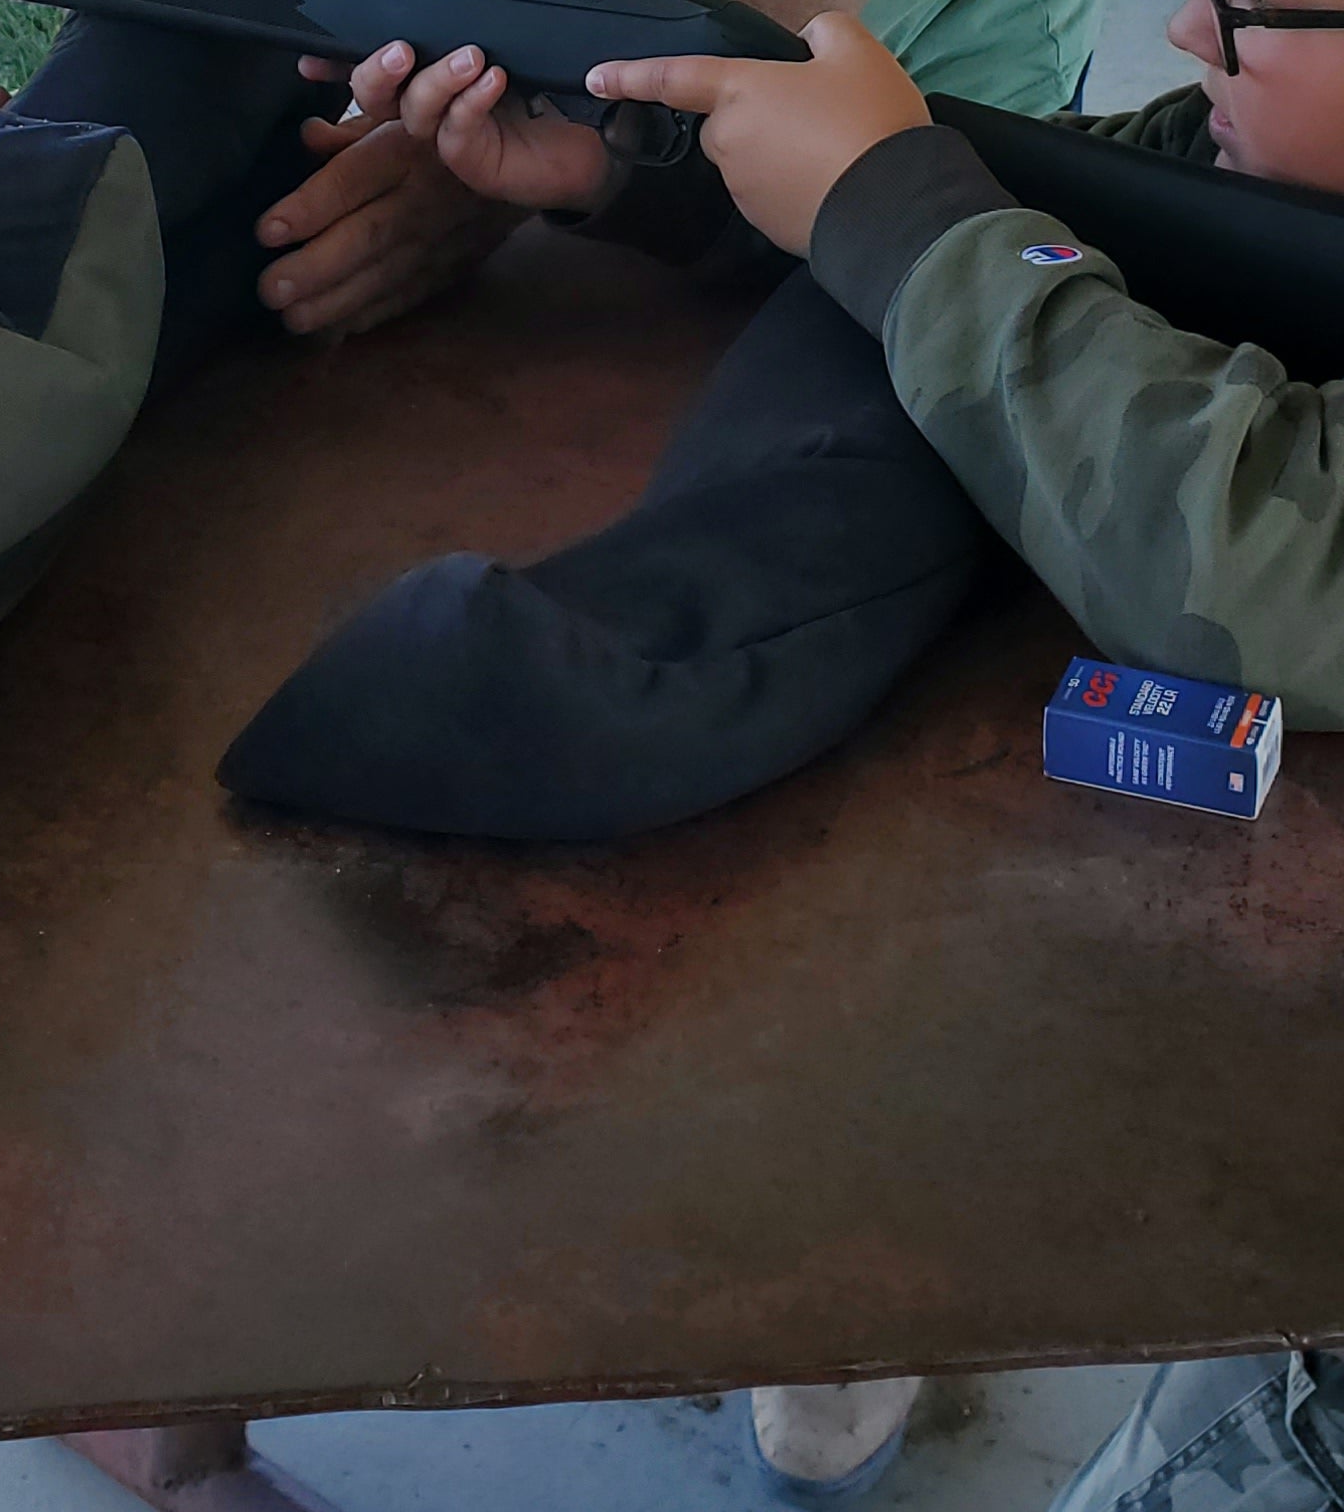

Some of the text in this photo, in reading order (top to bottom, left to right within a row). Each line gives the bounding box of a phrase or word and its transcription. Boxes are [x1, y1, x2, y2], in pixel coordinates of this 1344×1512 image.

[1128, 679, 1155, 716] STANDARD
[1141, 683, 1165, 716] VELOCITY
[1156, 701, 1174, 716] 22
